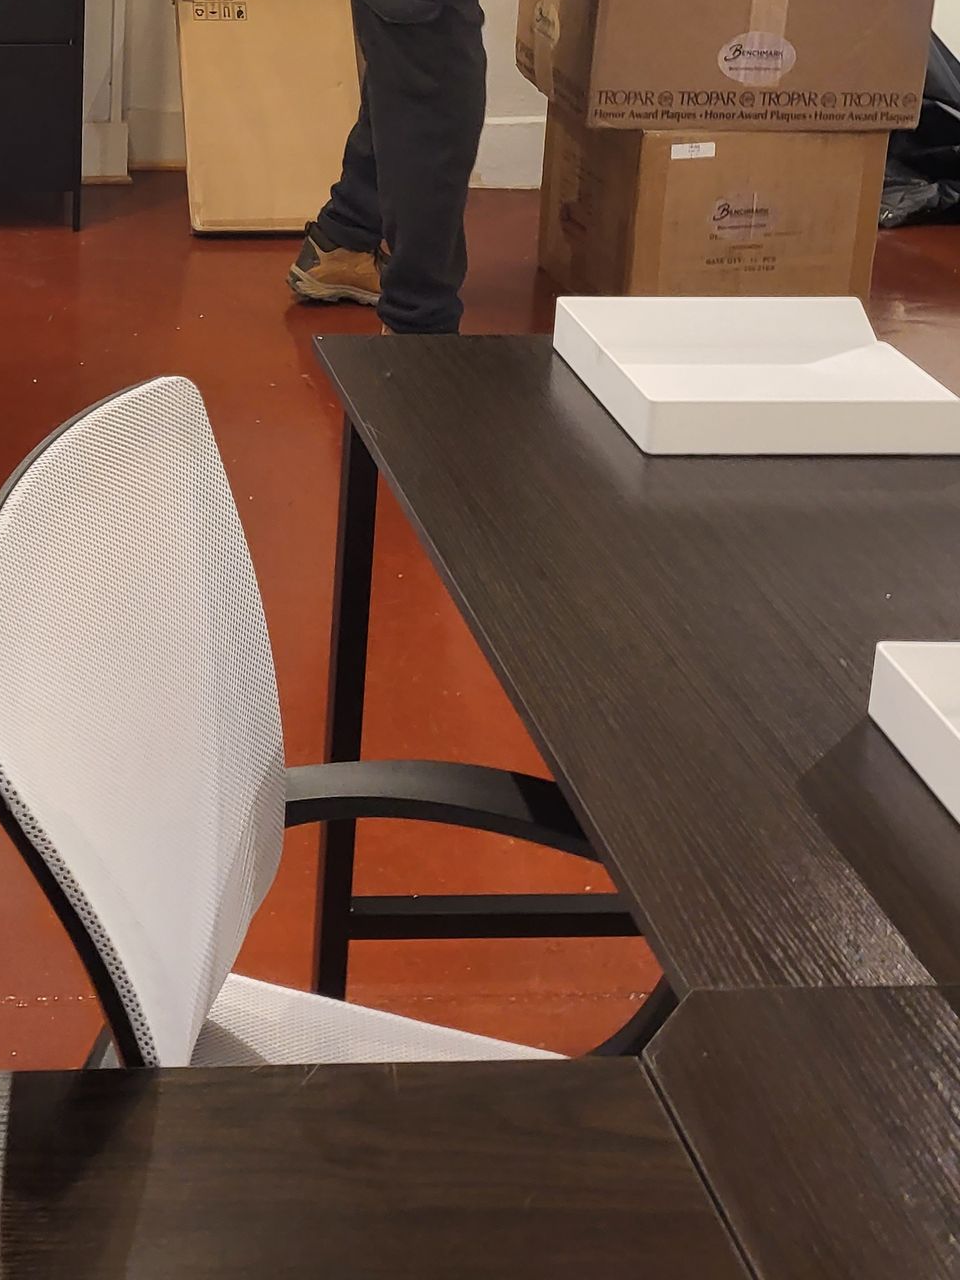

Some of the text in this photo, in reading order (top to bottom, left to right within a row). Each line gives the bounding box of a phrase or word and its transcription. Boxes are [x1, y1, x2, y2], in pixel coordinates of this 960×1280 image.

[724, 44, 783, 61] BENCHMARK
[598, 90, 899, 107] TROPAR TROPAR TROPAR TROPAR
[595, 108, 625, 119] Honor
[629, 109, 658, 119] Award
[661, 109, 696, 123] Plaques
[705, 109, 736, 120] Honor
[739, 109, 768, 120] Award
[770, 109, 806, 123] Plaques
[814, 110, 846, 121] Honor
[849, 110, 878, 121] Award
